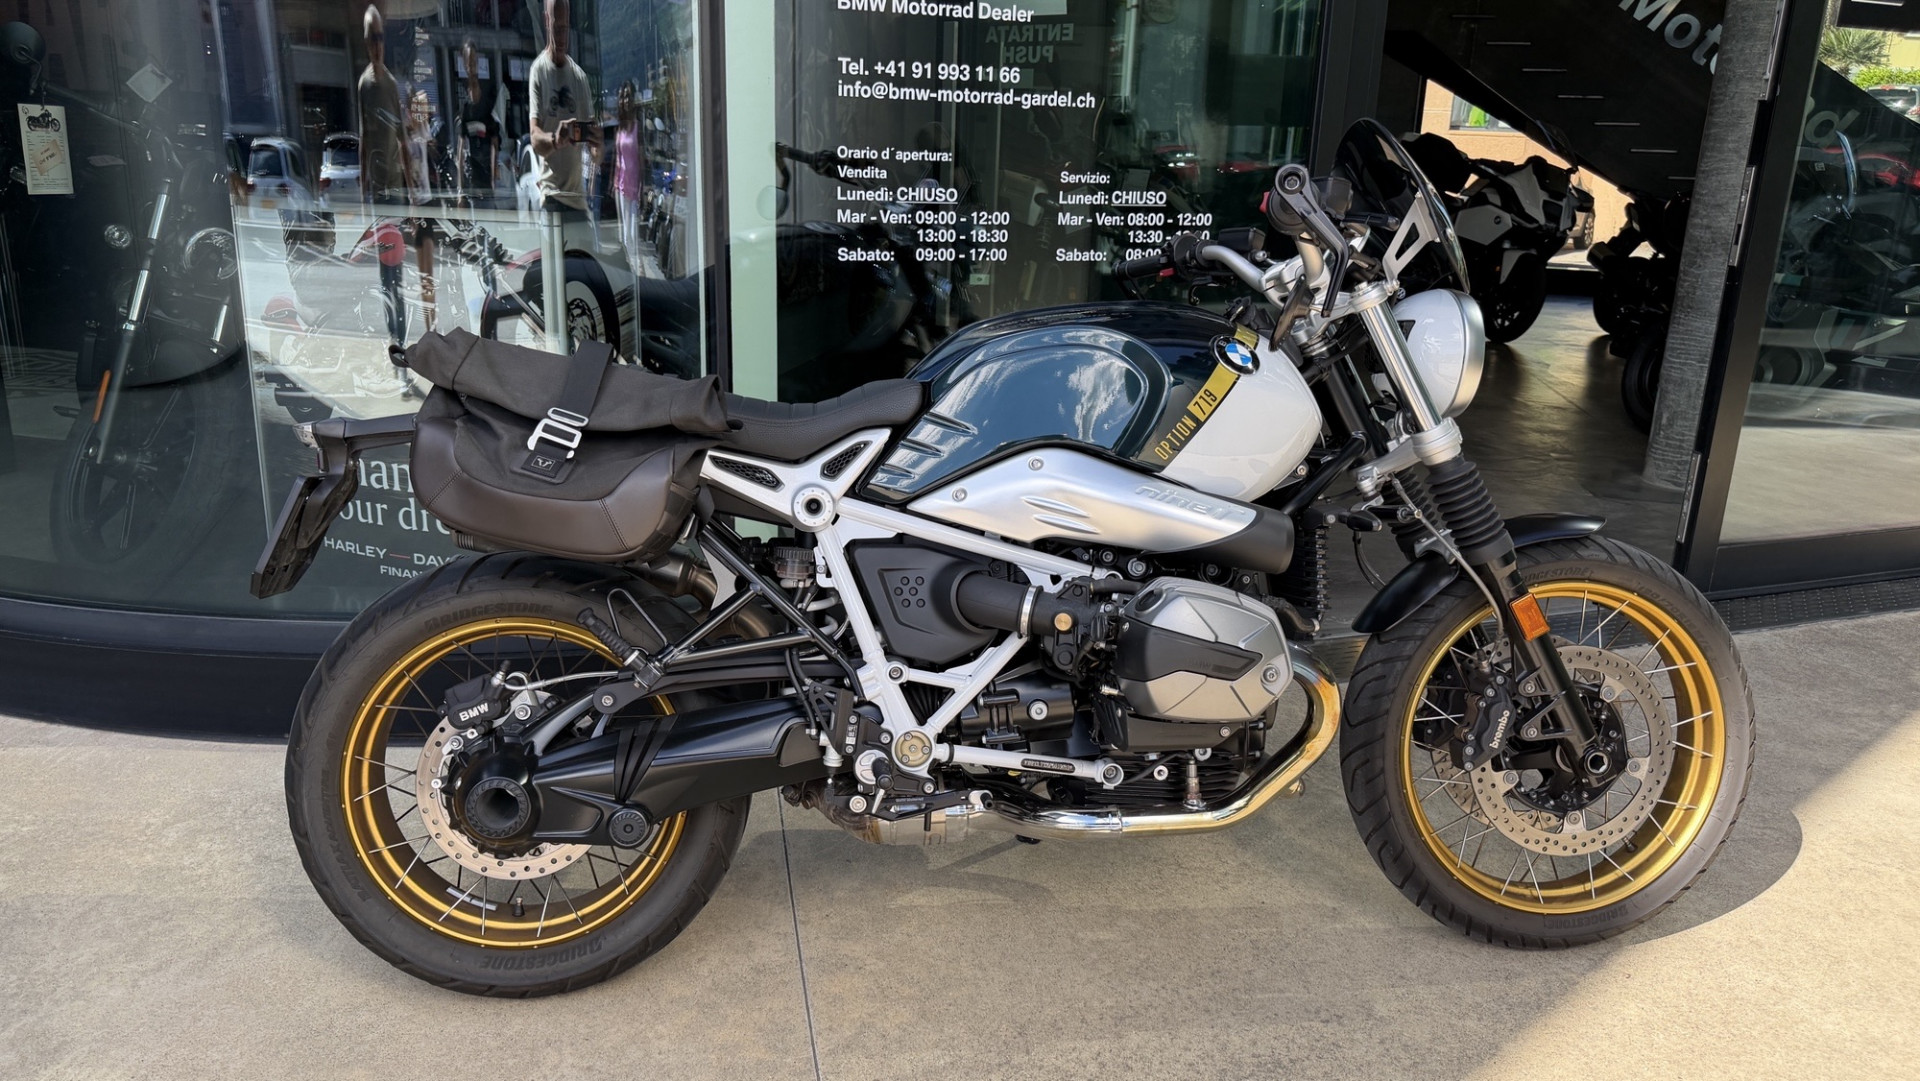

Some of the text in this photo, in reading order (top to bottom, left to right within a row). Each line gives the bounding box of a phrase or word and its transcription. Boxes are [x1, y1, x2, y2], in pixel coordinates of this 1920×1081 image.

[837, 0, 1035, 23] BMW Motorrad Dealer
[1618, 0, 1722, 75] Mot
[837, 57, 1021, 84] Tel. +41 91 993 11 66
[837, 81, 1096, 109] info@bmw-motorrad-gardel.ch
[836, 145, 879, 160] Orario
[837, 165, 888, 179] Vendita
[1060, 171, 1111, 184] Servizio:
[836, 185, 958, 203] Lunedì: CHIUSO
[1058, 190, 1167, 205] Lunedì: CHIUSO
[837, 209, 867, 225] Mar
[879, 210, 912, 225] Ven:
[915, 211, 957, 226] 09:00
[970, 211, 1010, 226] 12:00
[1057, 212, 1085, 226] Mar
[1095, 212, 1125, 226] Ven:
[1127, 212, 1165, 227] 08:00
[1177, 212, 1213, 227] 12:00
[916, 229, 957, 243] 13:00
[970, 229, 1009, 243] 18:30
[1127, 230, 1164, 243] 13:30
[837, 247, 895, 262] Sabato:
[915, 247, 956, 262] 09:00
[969, 248, 1008, 262] 17:00
[1055, 248, 1108, 262] Sabato:
[1154, 388, 1218, 460] OPTION 719
[324, 536, 387, 559] HARLEY
[424, 602, 553, 633] BRIDGESTONE
[458, 702, 489, 722] BMW
[1489, 710, 1510, 749] brembo
